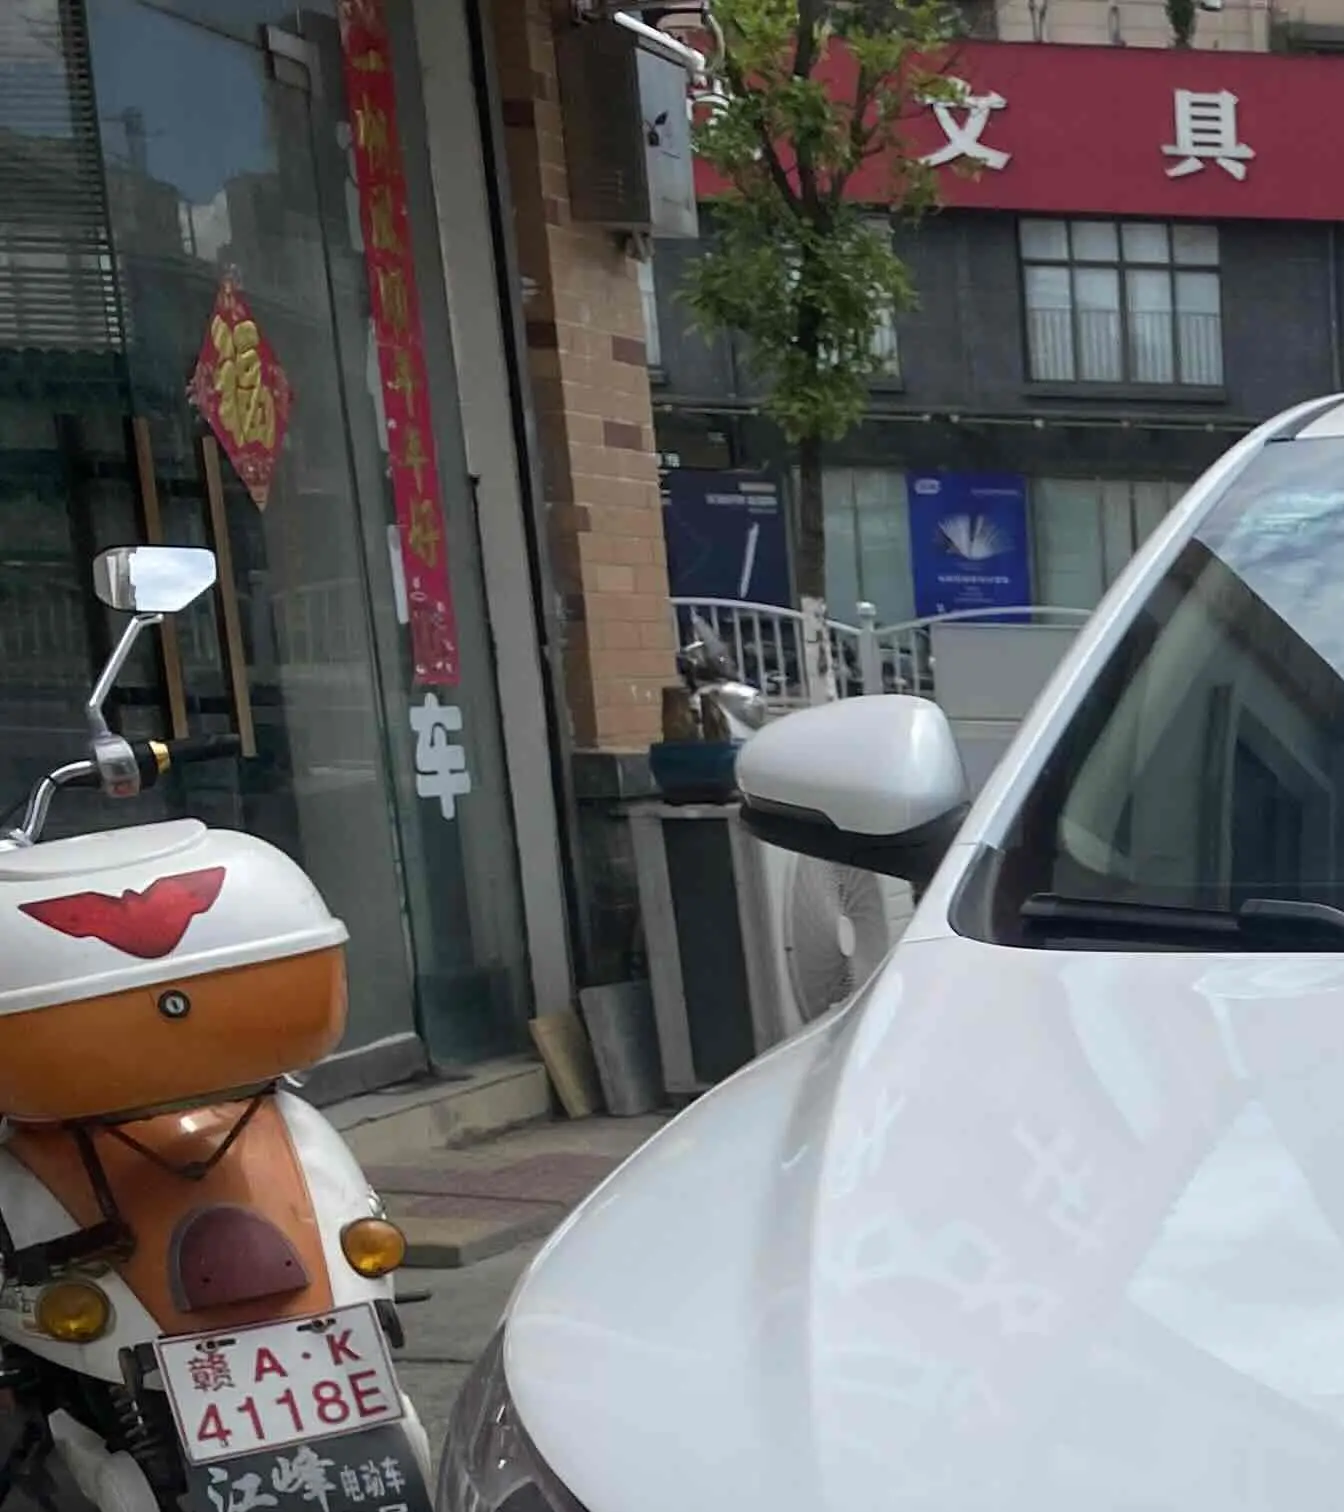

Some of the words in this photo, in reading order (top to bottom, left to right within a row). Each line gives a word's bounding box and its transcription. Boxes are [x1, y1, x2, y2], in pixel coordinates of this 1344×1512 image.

[210, 313, 277, 450] 福
[409, 692, 471, 820] 车
[197, 1368, 389, 1443] 4118E
[340, 1455, 407, 1502] 电动车
